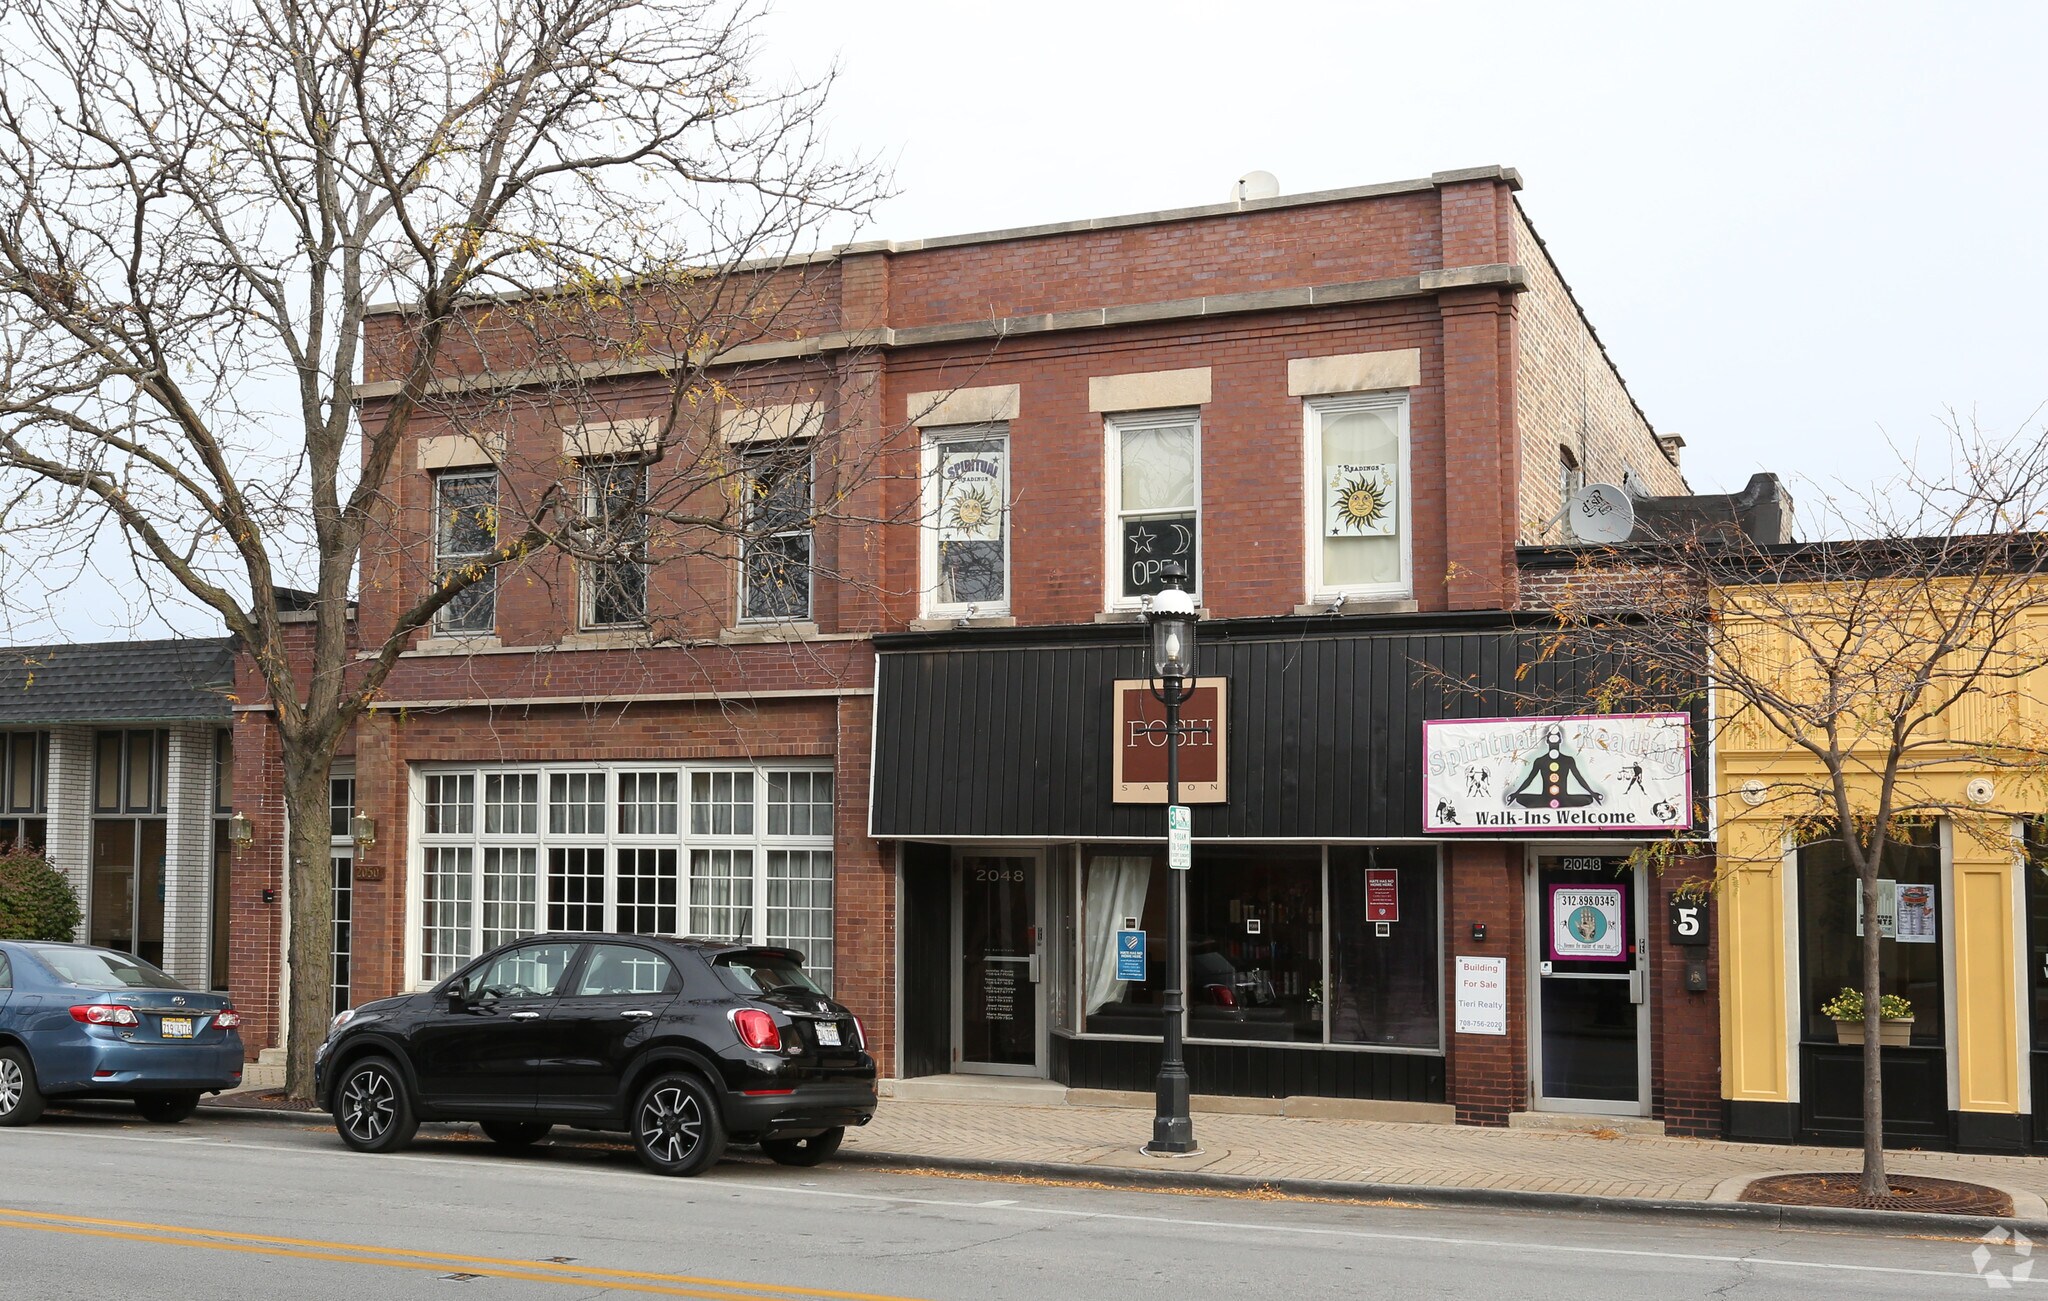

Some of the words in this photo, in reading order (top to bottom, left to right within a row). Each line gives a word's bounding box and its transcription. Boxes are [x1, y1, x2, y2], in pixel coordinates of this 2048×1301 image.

[947, 459, 999, 478] SPIRITUAL
[1429, 729, 1539, 778] Spiritual
[1576, 723, 1686, 776] Reading
[1475, 810, 1551, 826] Walk-Ins
[1557, 810, 1637, 825] Welcome
[1563, 859, 1602, 871] 2048
[976, 870, 1025, 882] 2048
[1678, 907, 1700, 936] 5
[1463, 963, 1498, 973] Building
[1463, 980, 1477, 988] For
[1479, 980, 1498, 989] Sale
[1458, 999, 1476, 1008] Tieri
[1478, 1000, 1503, 1010] Realty
[1459, 1019, 1503, 1028] 708-756-2020
